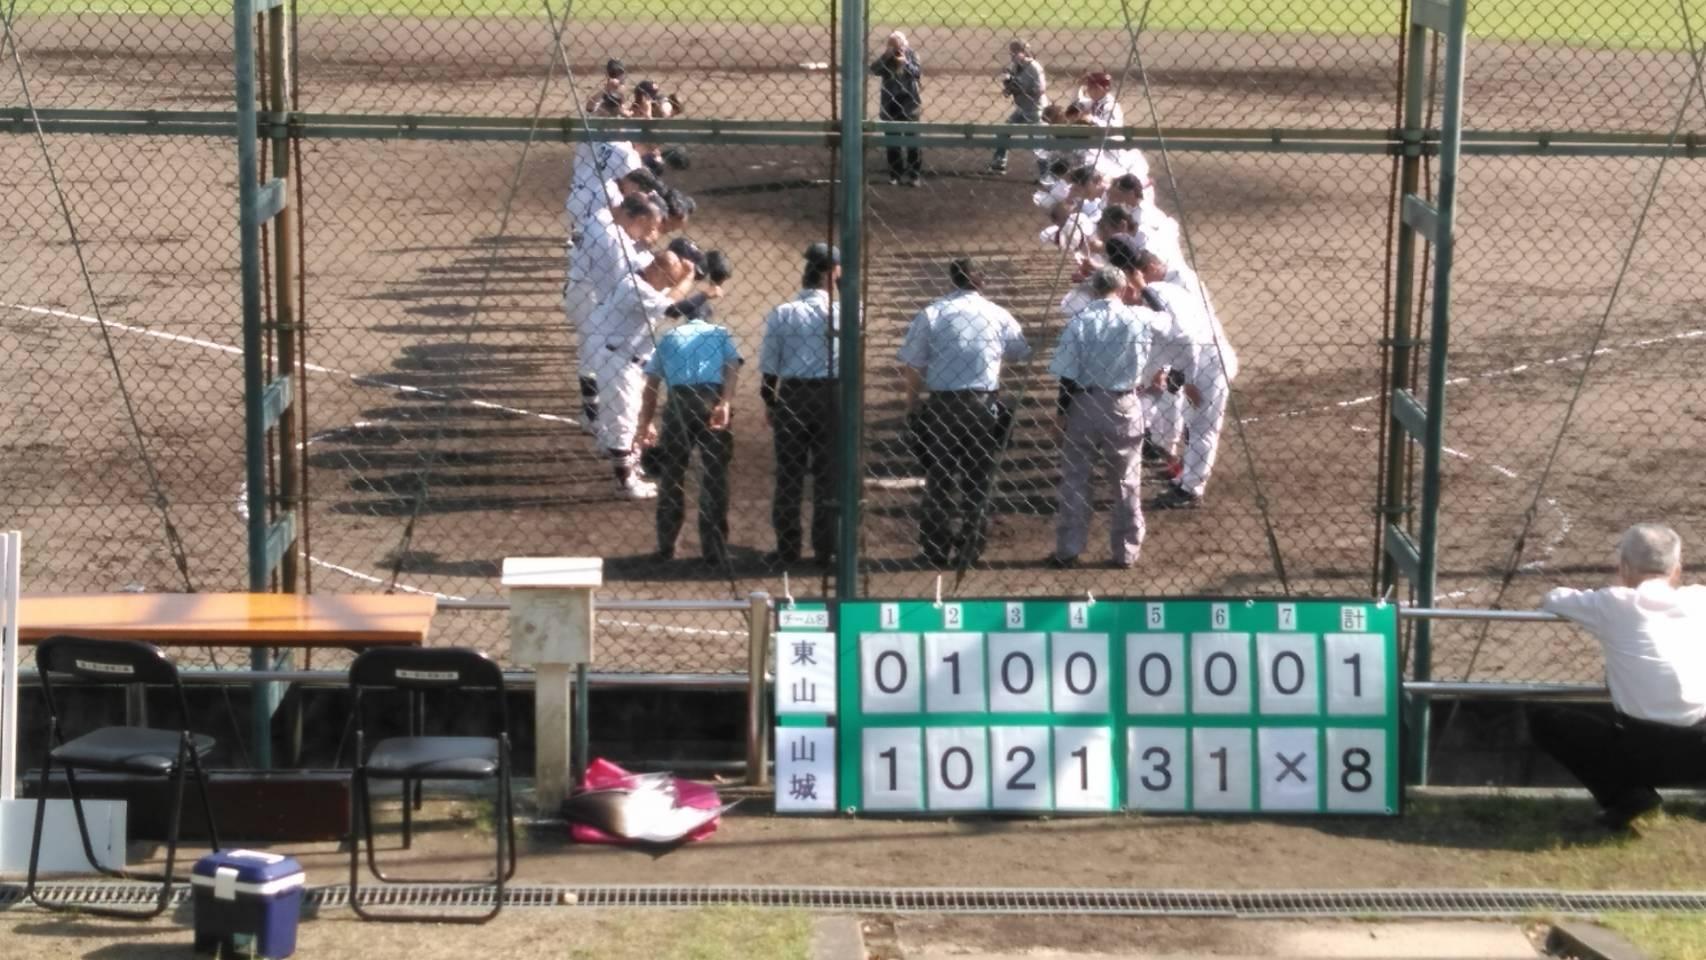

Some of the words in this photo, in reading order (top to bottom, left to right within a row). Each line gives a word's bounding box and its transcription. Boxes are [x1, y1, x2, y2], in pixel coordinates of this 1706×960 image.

[782, 613, 826, 625] チーム名
[886, 607, 894, 625] 1
[948, 607, 959, 625] 2
[1010, 607, 1021, 625] 3
[1073, 607, 1084, 625] 4
[1151, 608, 1161, 625] 5
[1215, 609, 1226, 625] 6
[1282, 609, 1292, 625] 7
[1344, 609, 1364, 629] 計
[791, 640, 817, 703] 東山
[874, 650, 908, 695] 0
[942, 651, 961, 695] 1
[1000, 651, 1034, 695] 0
[1064, 651, 1097, 696] 0
[1138, 652, 1172, 697] 0
[1203, 651, 1237, 696] 0
[1271, 651, 1305, 695] 0
[1343, 653, 1362, 697] 1
[789, 735, 817, 801] 山城
[879, 746, 898, 791] 1
[940, 746, 974, 791] 0
[1005, 746, 1036, 791] 2
[1071, 746, 1088, 791] 1
[1141, 746, 1172, 792] 3
[1209, 747, 1228, 791] 1
[1340, 747, 1372, 792] 8
